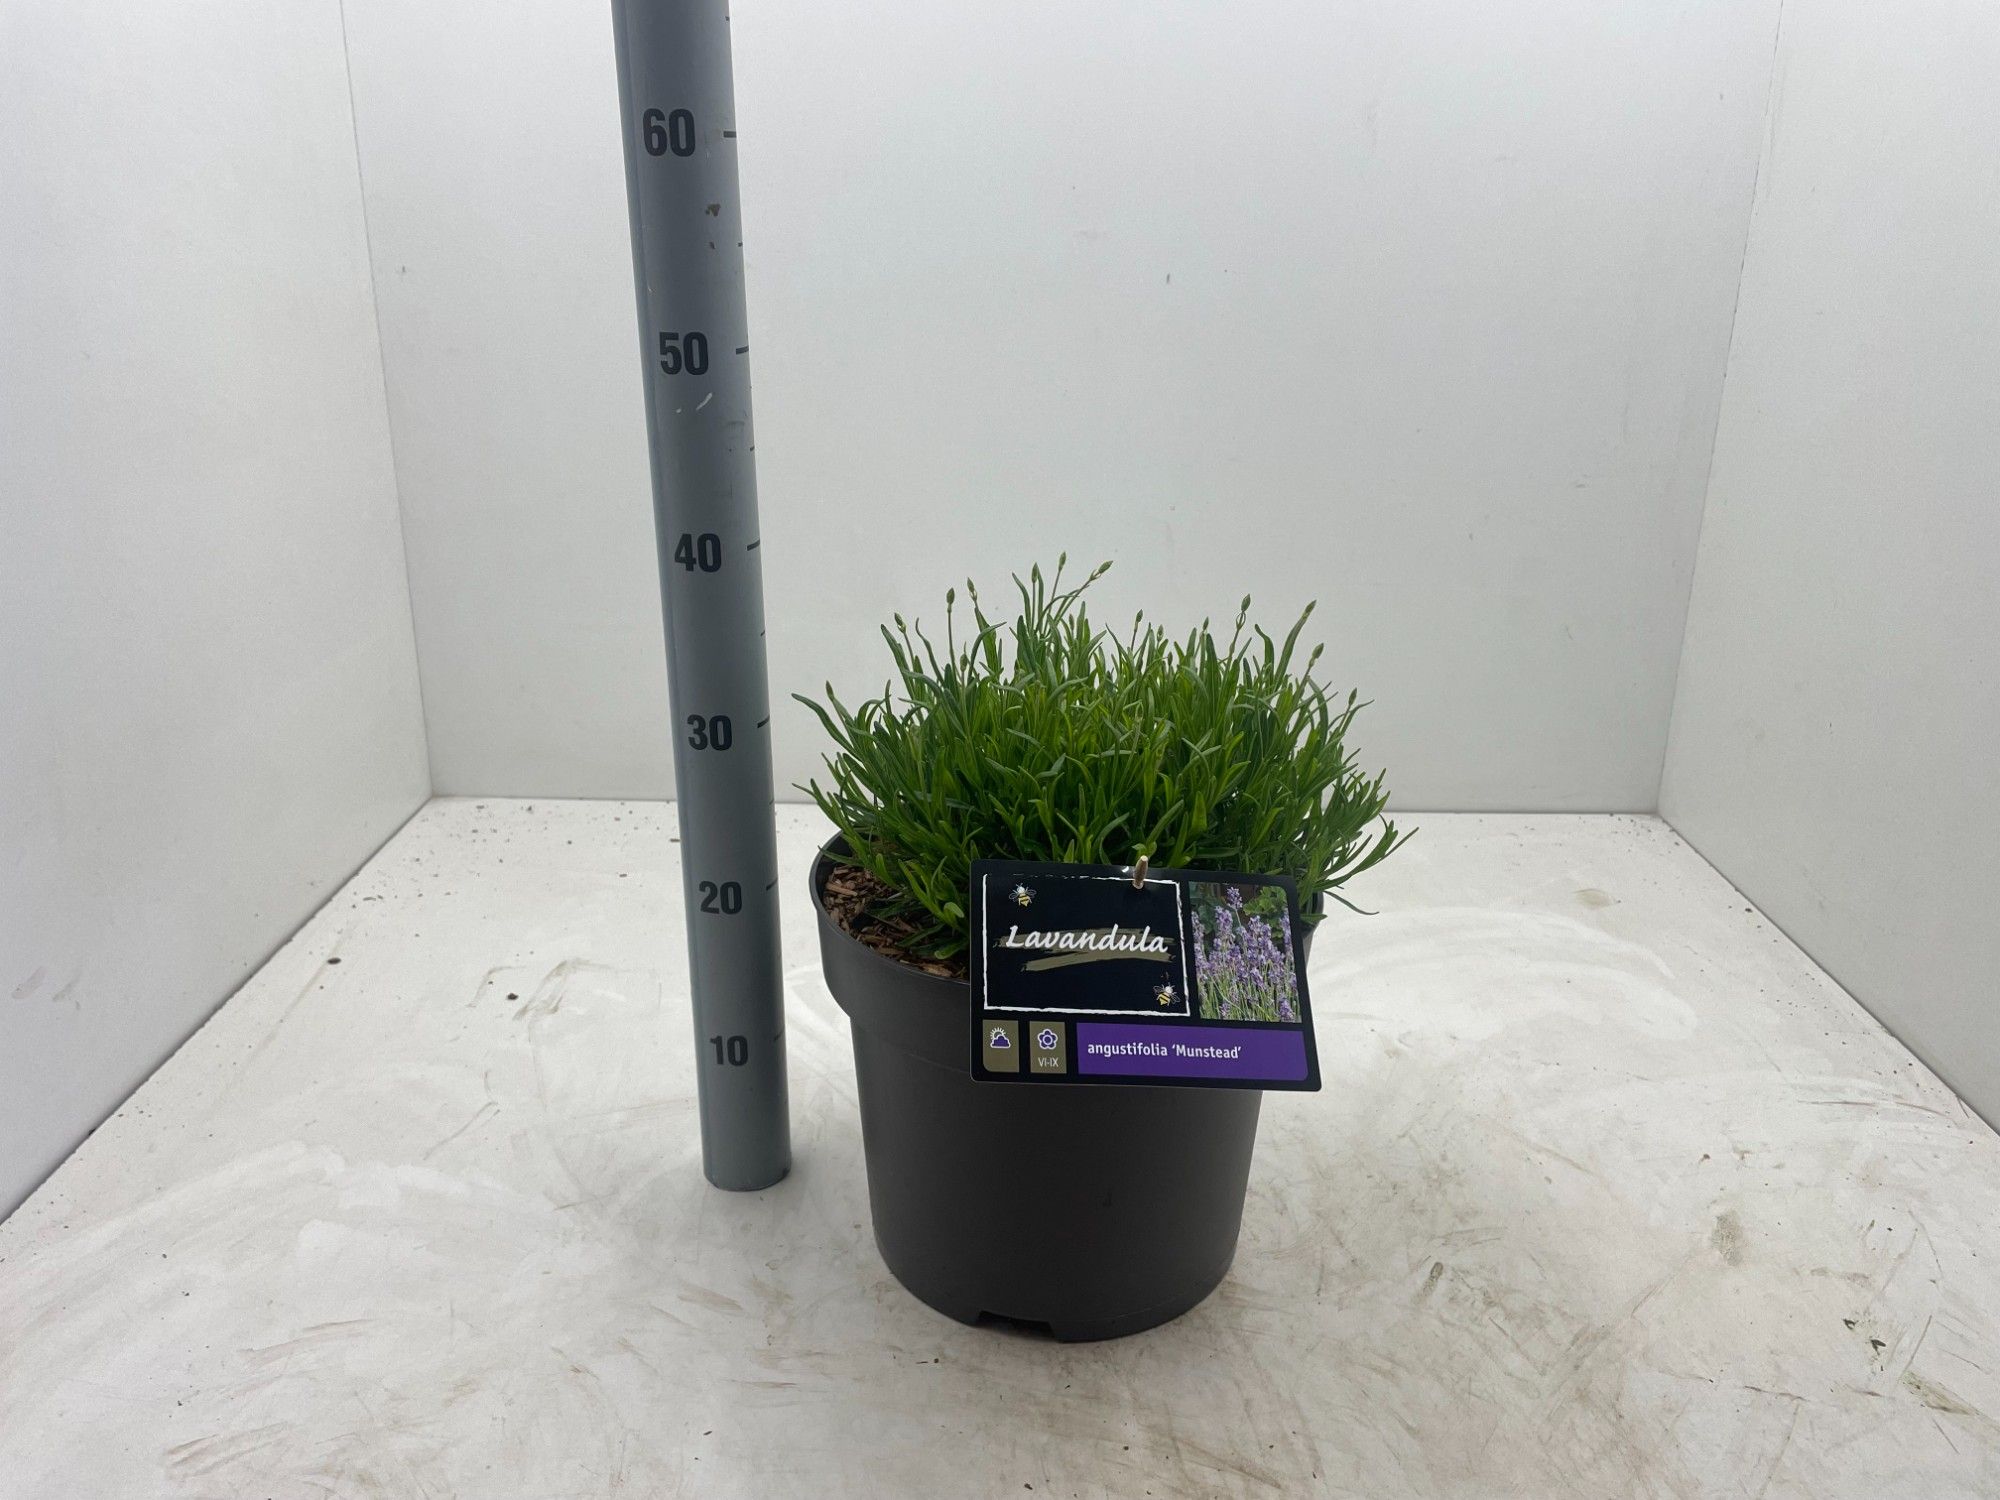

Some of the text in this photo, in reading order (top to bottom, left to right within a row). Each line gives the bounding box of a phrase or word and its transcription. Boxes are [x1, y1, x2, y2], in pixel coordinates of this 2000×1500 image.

[643, 108, 696, 157] 60
[659, 331, 709, 375] 50
[674, 533, 722, 572] 40
[687, 714, 733, 751] 30
[698, 880, 743, 915] 20
[1006, 923, 1168, 953] Lavandula
[709, 1035, 749, 1067] 10
[1038, 1057, 1059, 1068] VI-IX
[1087, 1041, 1168, 1058] angustifolia
